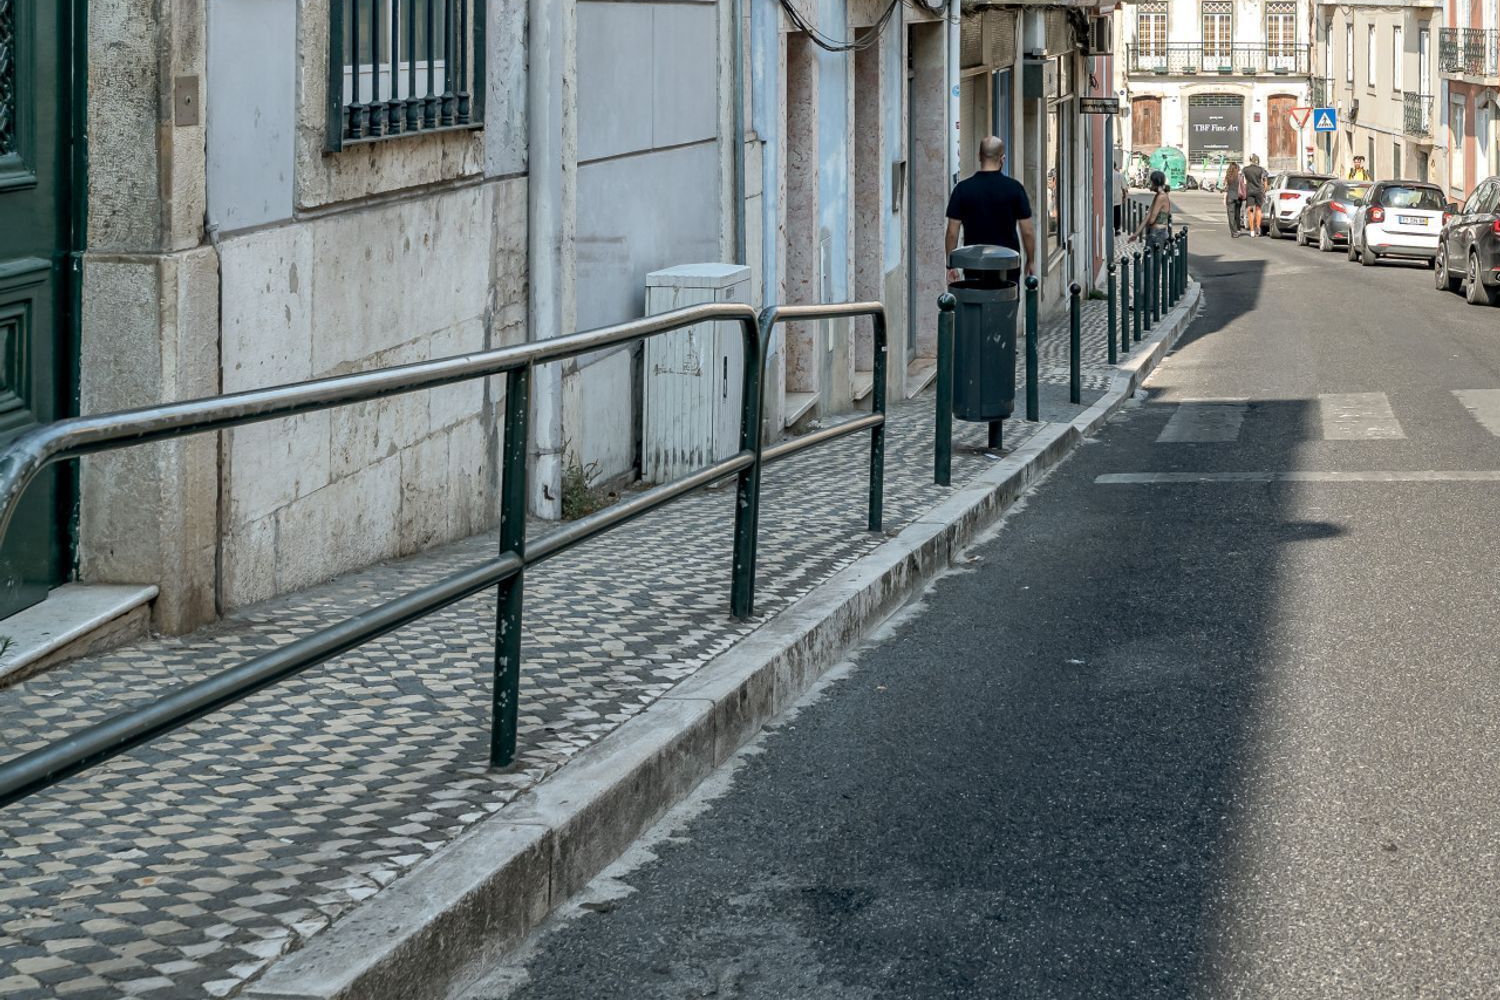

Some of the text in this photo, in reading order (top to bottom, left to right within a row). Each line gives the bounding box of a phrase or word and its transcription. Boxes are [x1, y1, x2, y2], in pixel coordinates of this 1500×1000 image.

[1193, 123, 1239, 132] TBF Fine Art
